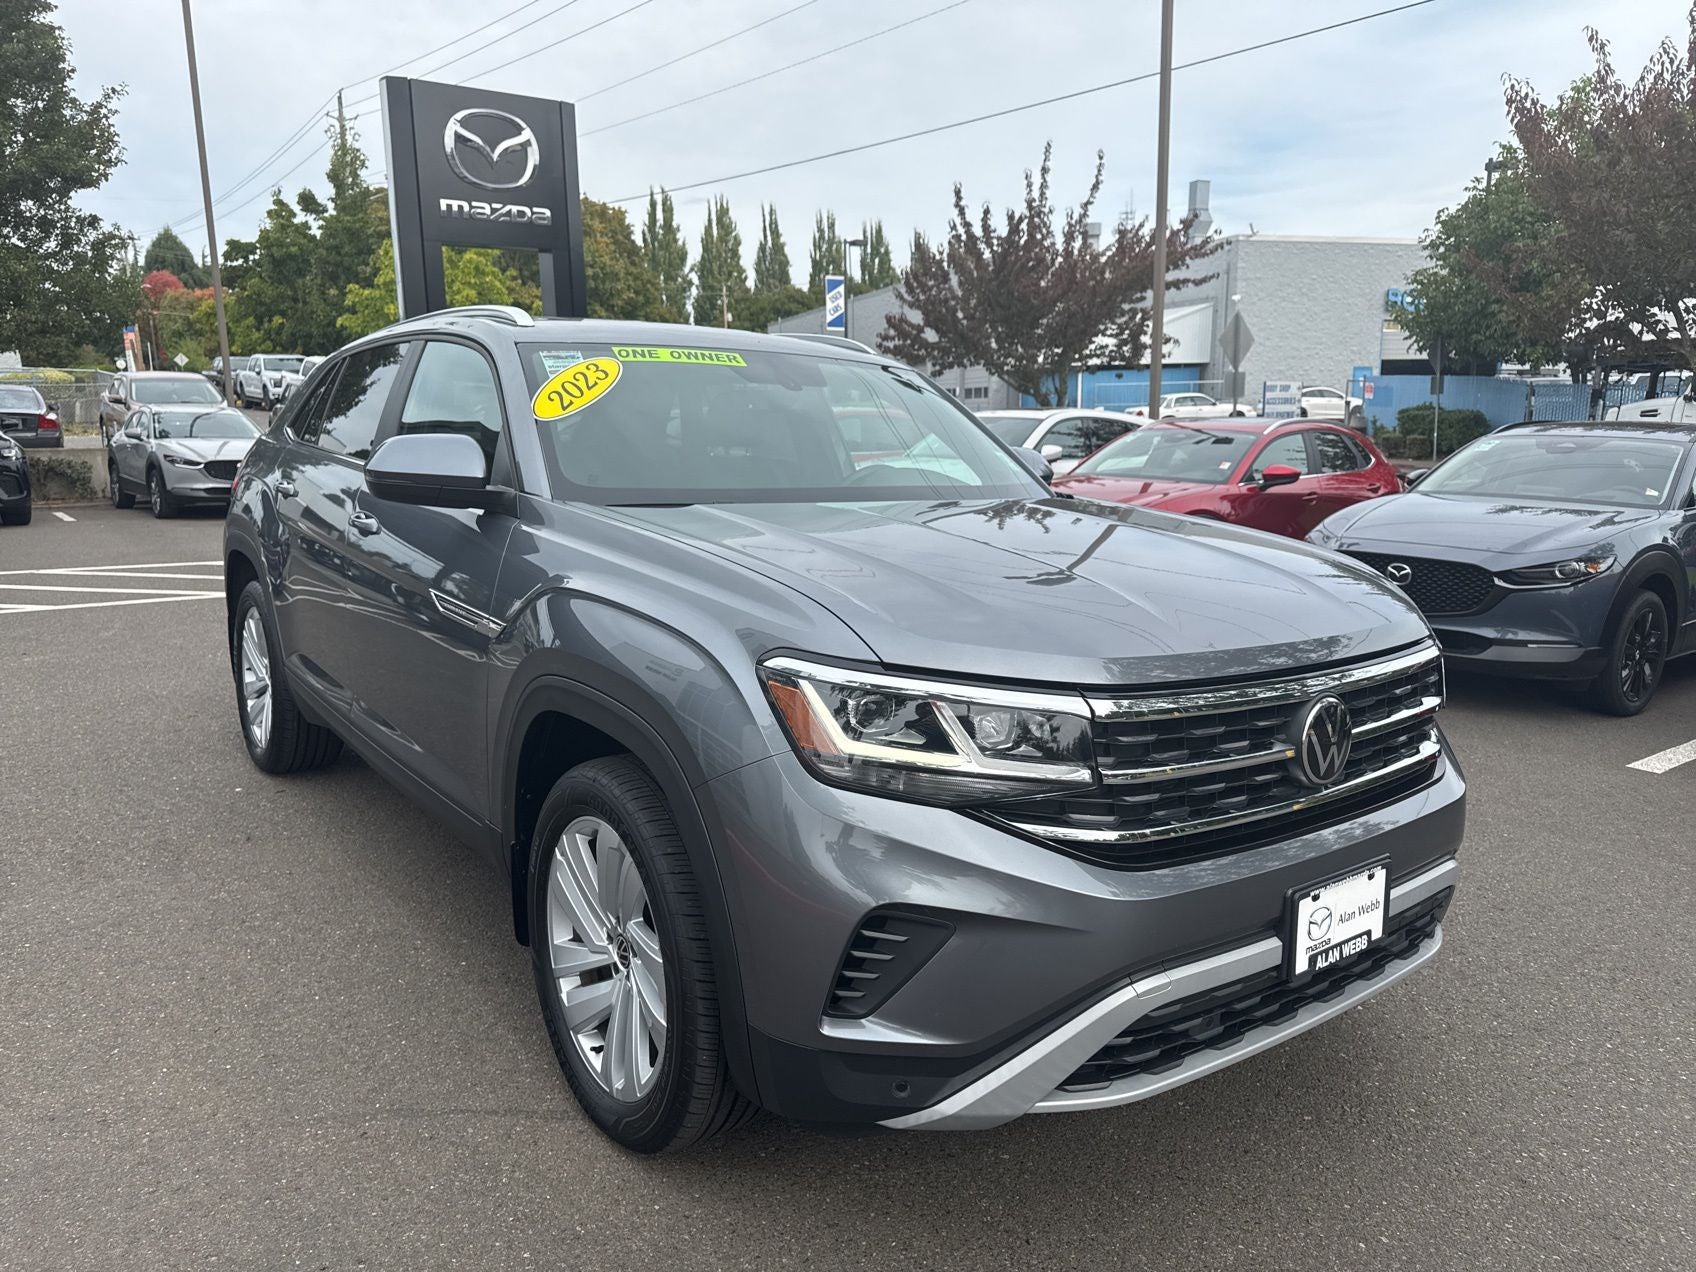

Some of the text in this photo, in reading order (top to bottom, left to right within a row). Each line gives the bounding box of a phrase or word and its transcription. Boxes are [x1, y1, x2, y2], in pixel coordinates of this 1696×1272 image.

[617, 348, 741, 364] ONE OWNER
[547, 363, 609, 411] 2023
[1337, 898, 1380, 926] Alan Webb
[1316, 934, 1368, 971] ALAN WEBB
